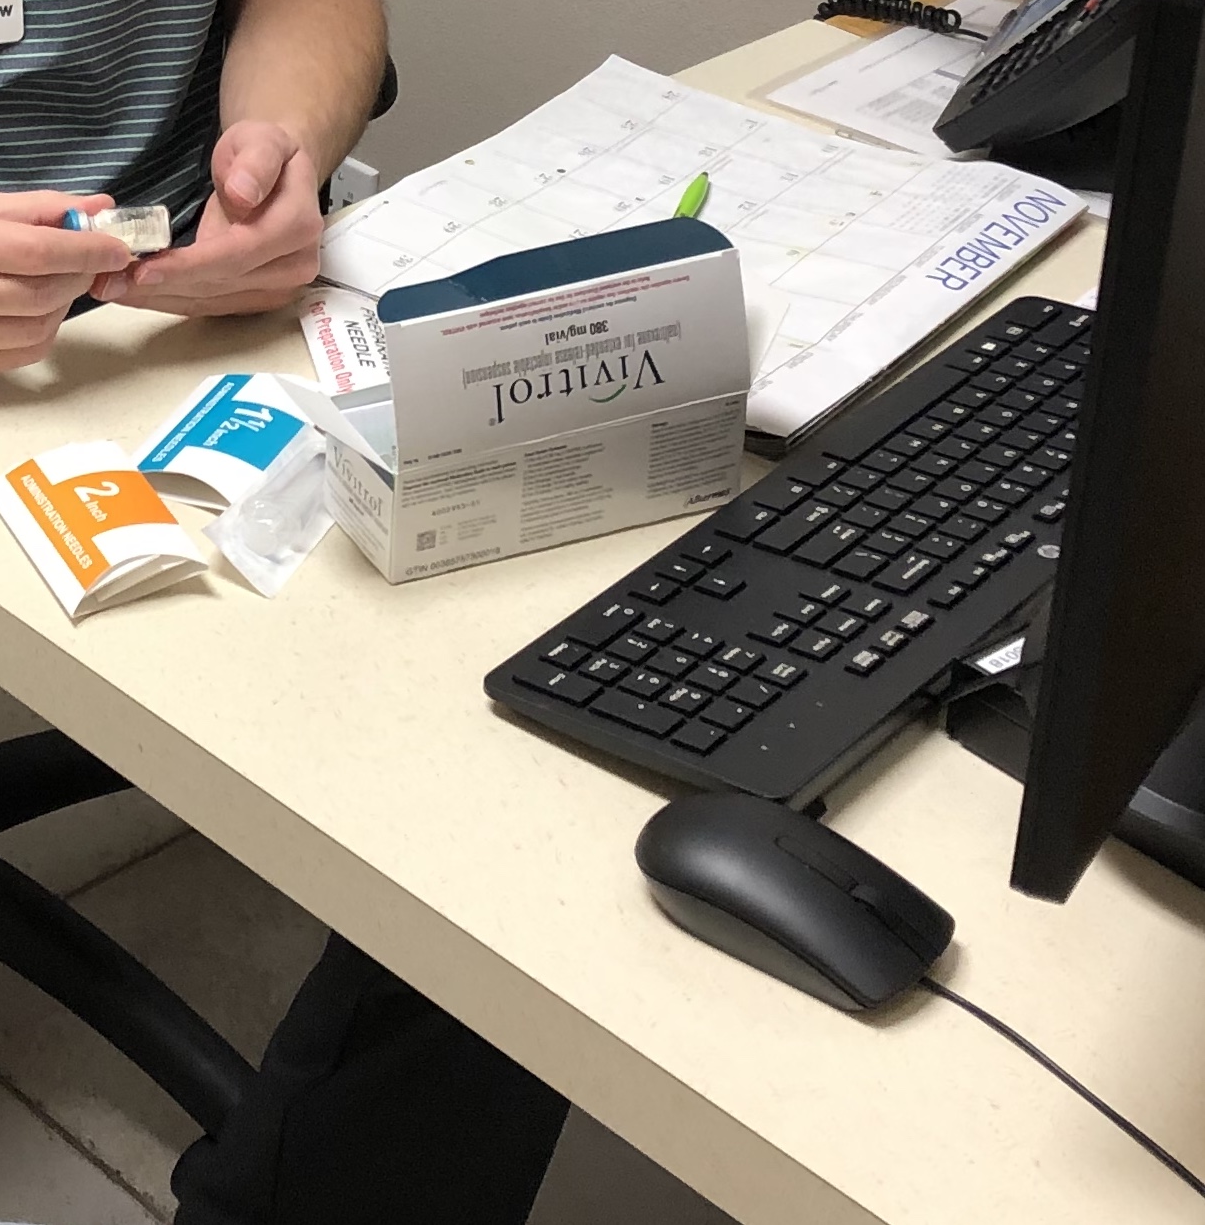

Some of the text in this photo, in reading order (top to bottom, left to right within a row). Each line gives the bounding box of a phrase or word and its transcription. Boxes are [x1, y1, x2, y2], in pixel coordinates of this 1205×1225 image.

[925, 188, 1067, 291] NOVEMBER
[309, 300, 356, 394] For Preparation Only
[344, 320, 376, 368] NEEDLE
[545, 322, 587, 346] mg/vial
[589, 320, 609, 335] 380
[151, 382, 235, 463] ADMINISTRATION NEEDLES
[74, 480, 120, 522] 2 Inch
[333, 445, 383, 517] Vivitrol
[20, 474, 93, 570] ADMINISTRATION NEEDLES
